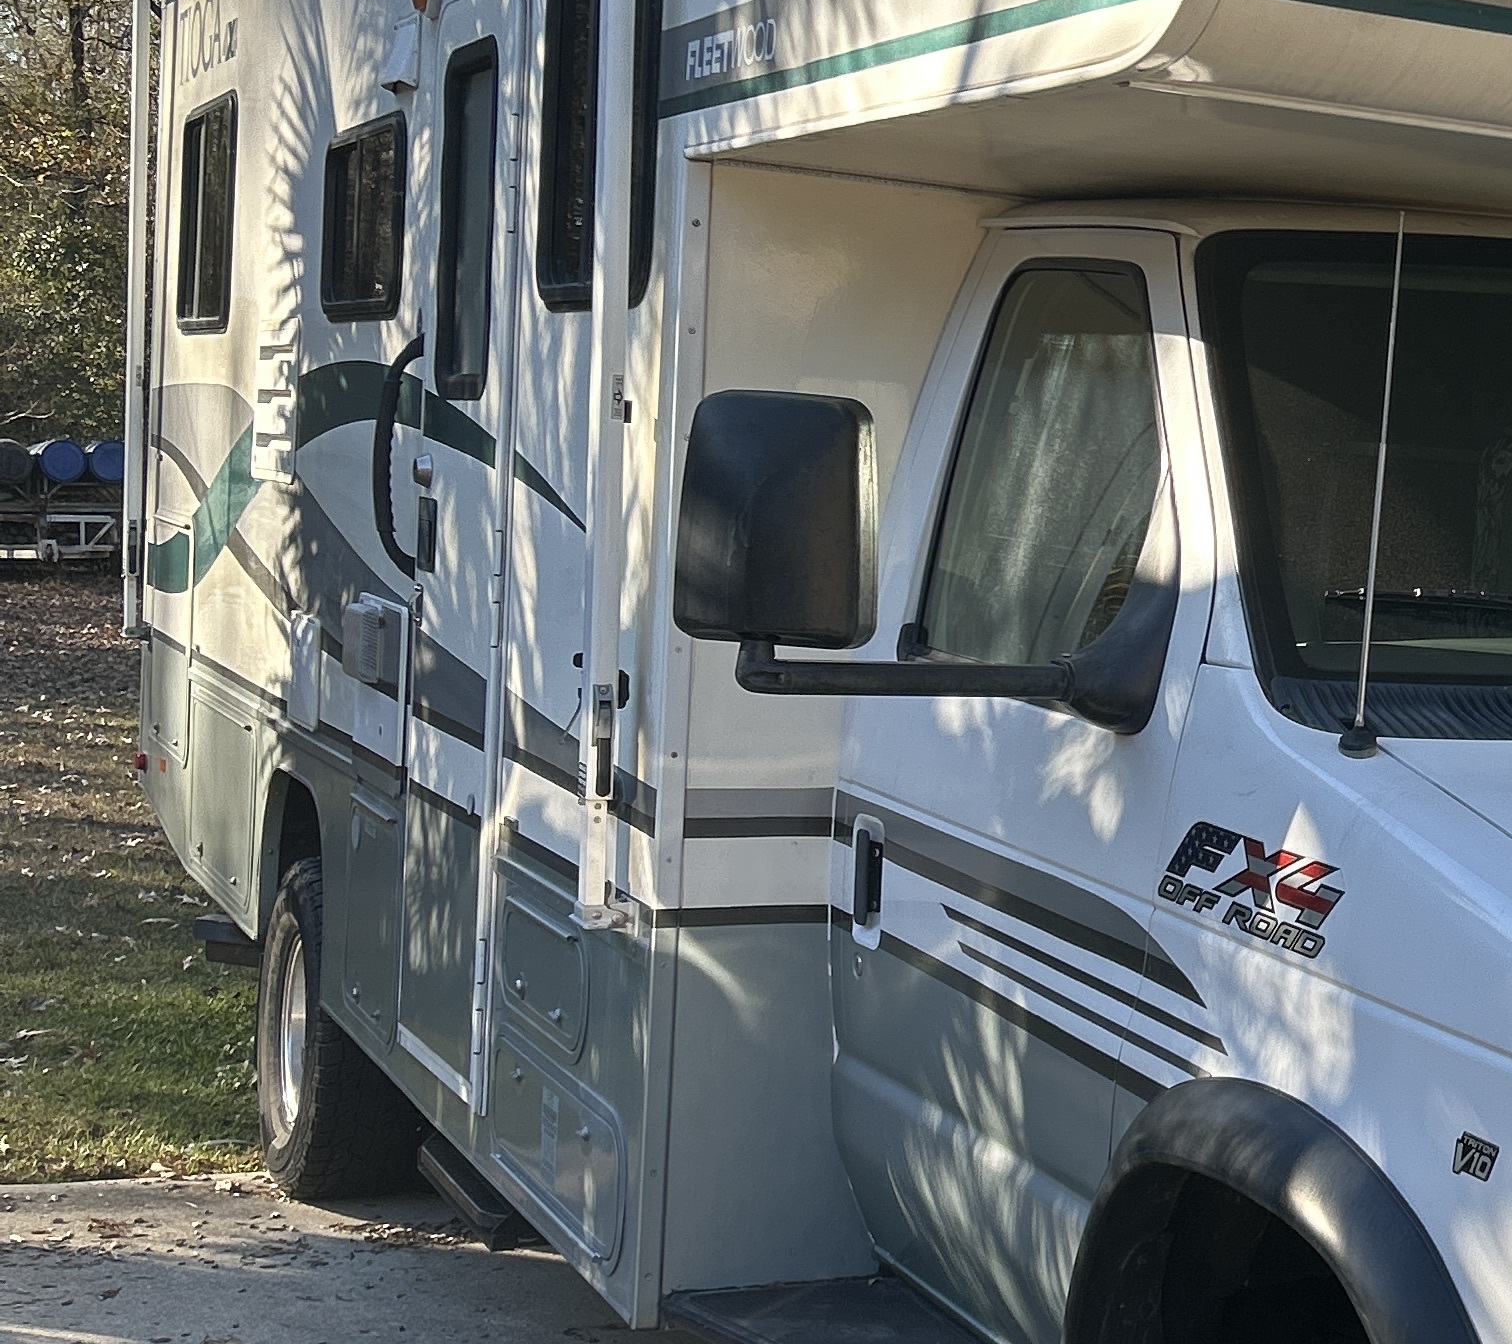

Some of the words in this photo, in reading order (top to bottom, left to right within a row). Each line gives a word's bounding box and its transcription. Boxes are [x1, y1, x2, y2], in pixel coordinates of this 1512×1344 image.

[686, 18, 777, 81] FLEETWOOD
[1165, 820, 1346, 930] FX4
[1157, 875, 1221, 913] OFF
[1222, 902, 1326, 959] ROAD
[1453, 1142, 1492, 1178] V10
[1463, 1135, 1498, 1157] TRITON
